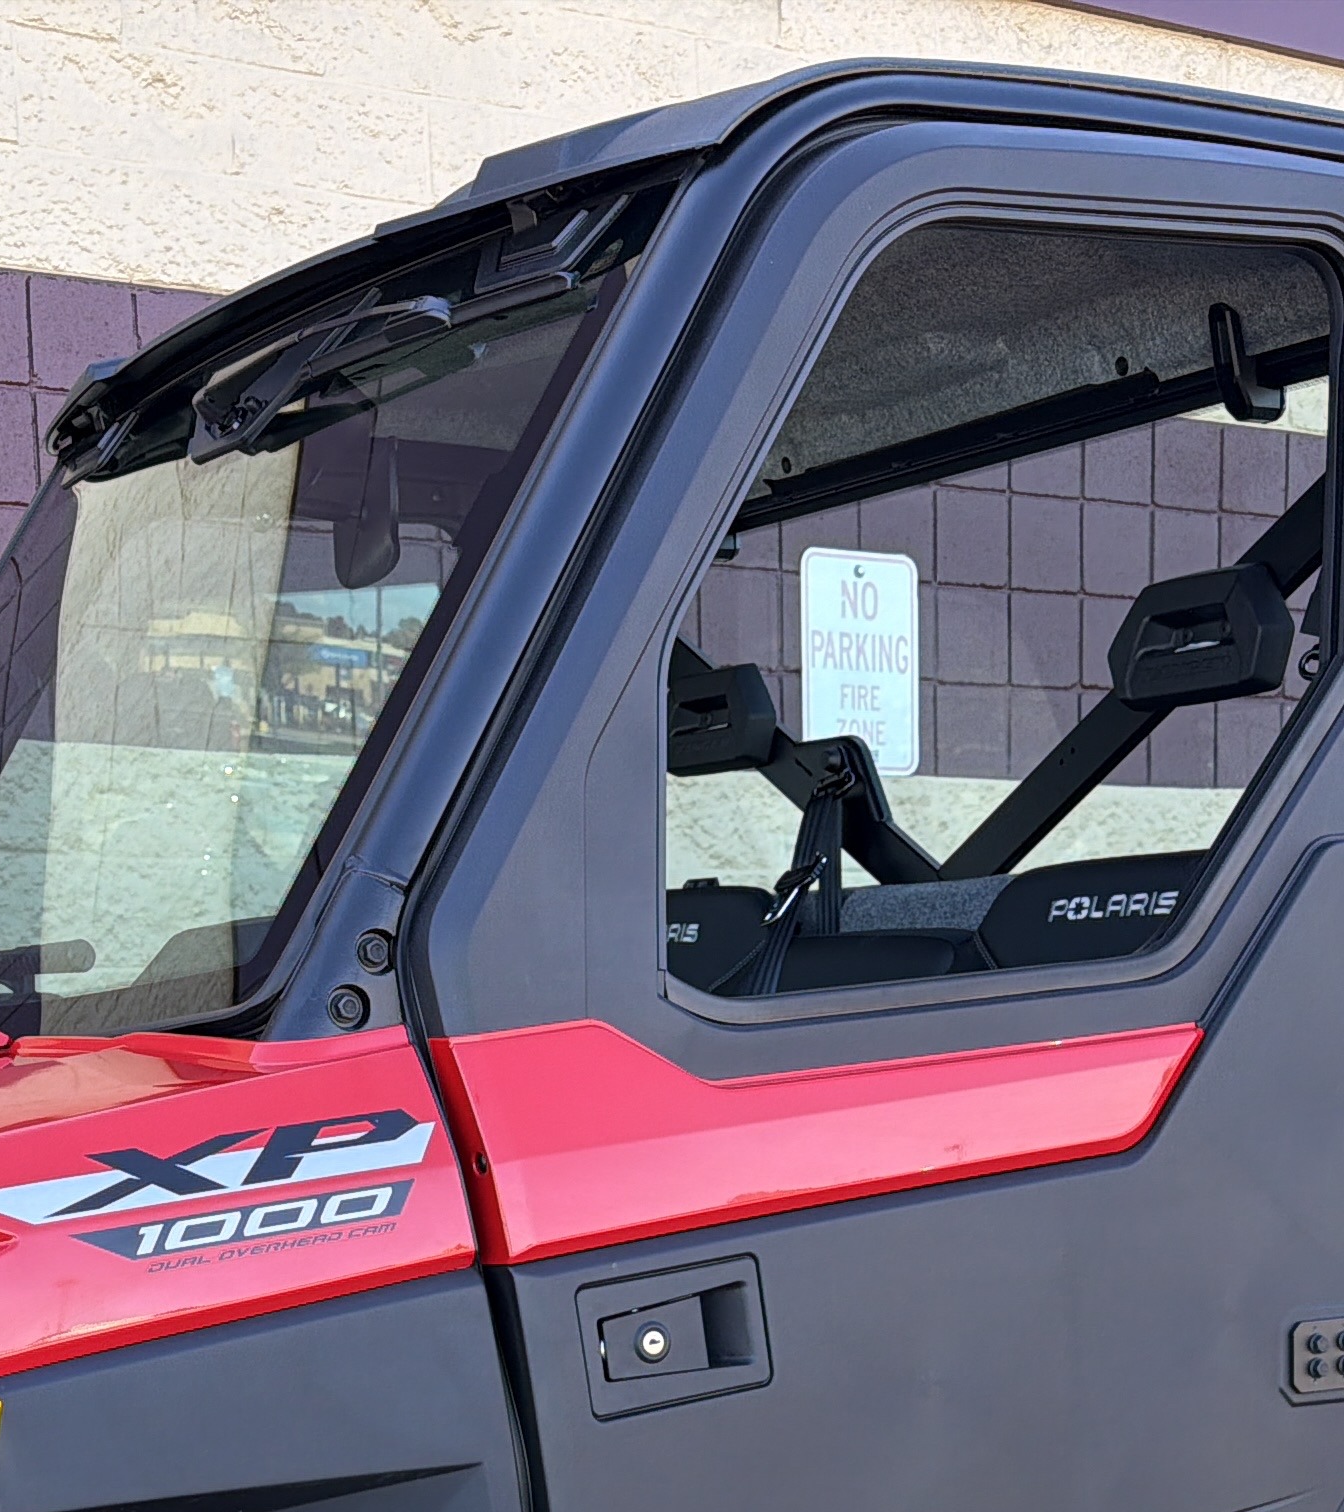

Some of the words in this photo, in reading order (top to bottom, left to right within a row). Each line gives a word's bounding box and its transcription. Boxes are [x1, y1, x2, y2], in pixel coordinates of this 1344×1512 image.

[840, 579, 879, 621] NO
[811, 629, 909, 675] PARKING
[840, 683, 881, 712] FIRE
[1047, 890, 1180, 922] POLARIS
[43, 1108, 420, 1219] XP
[135, 1186, 394, 1256] 1000
[148, 1256, 211, 1274] DUAL
[218, 1232, 343, 1262] OVERHEAD
[347, 1222, 397, 1239] CAM
